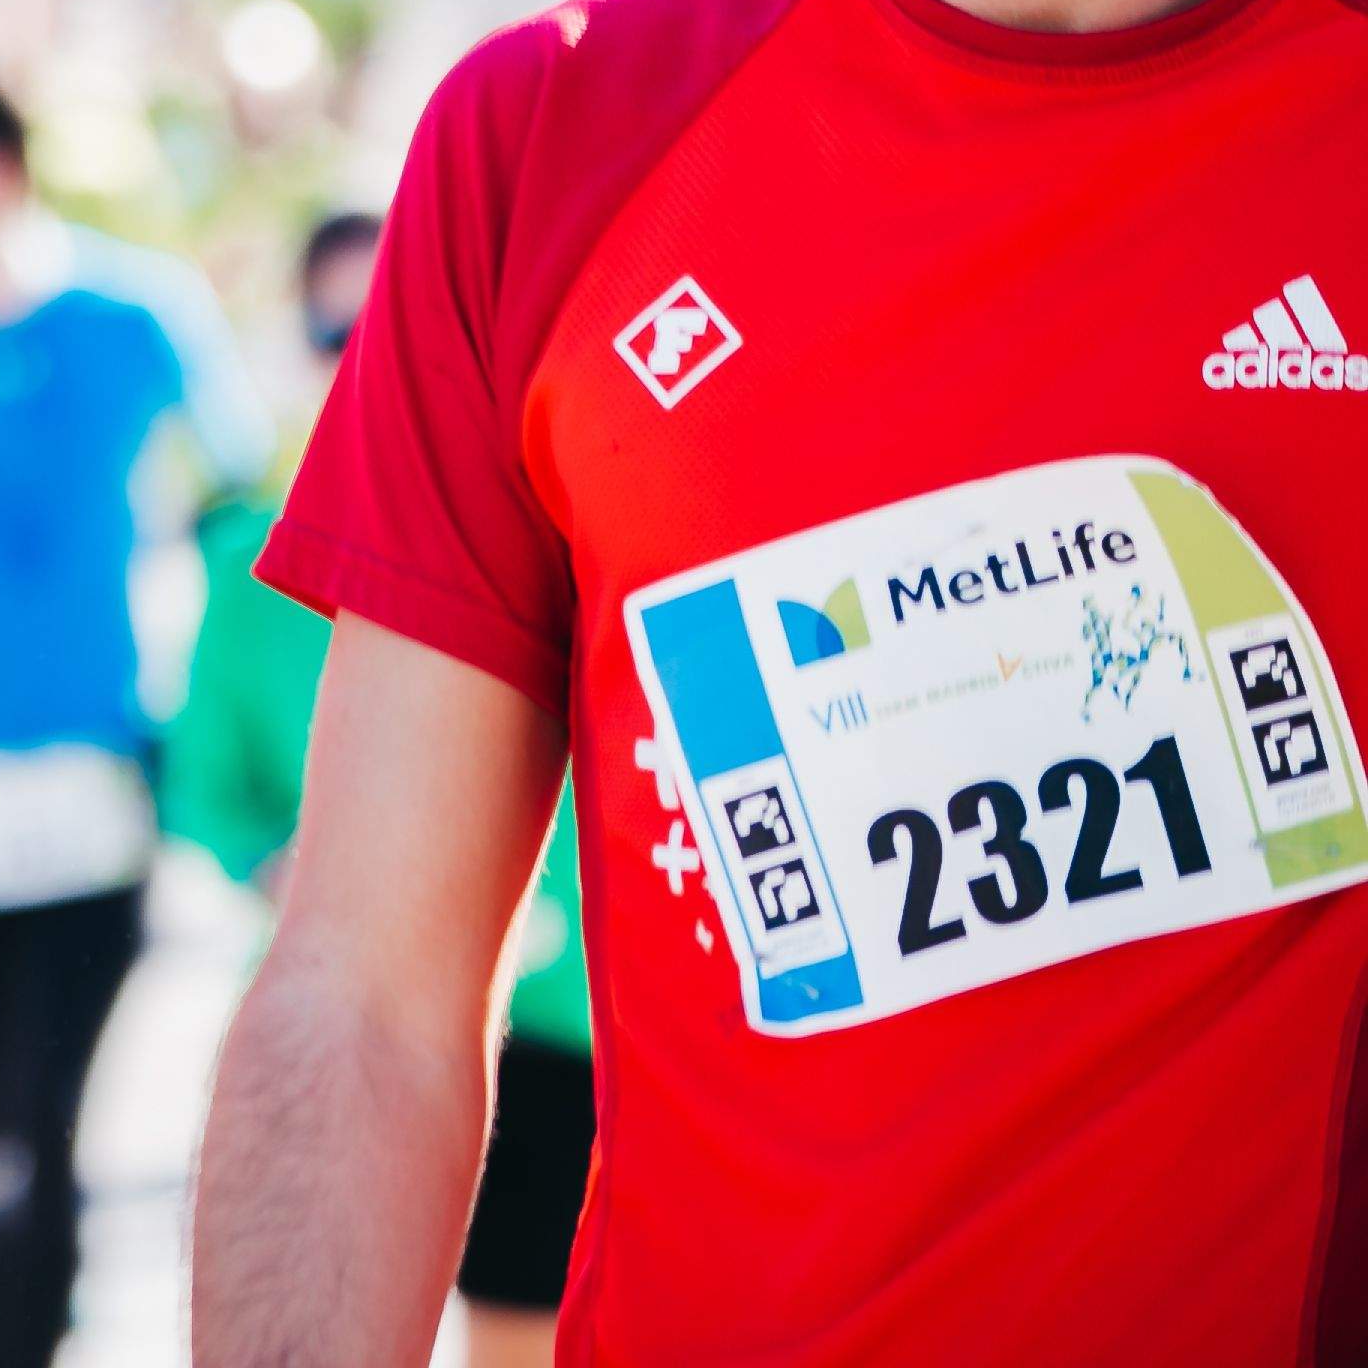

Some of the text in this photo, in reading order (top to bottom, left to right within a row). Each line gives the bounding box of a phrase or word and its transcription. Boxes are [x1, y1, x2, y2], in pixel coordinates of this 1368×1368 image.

[1202, 342, 1368, 390] adidas
[887, 522, 1138, 625] MetLife
[810, 690, 868, 734] VIII
[866, 734, 1212, 958] 2321
